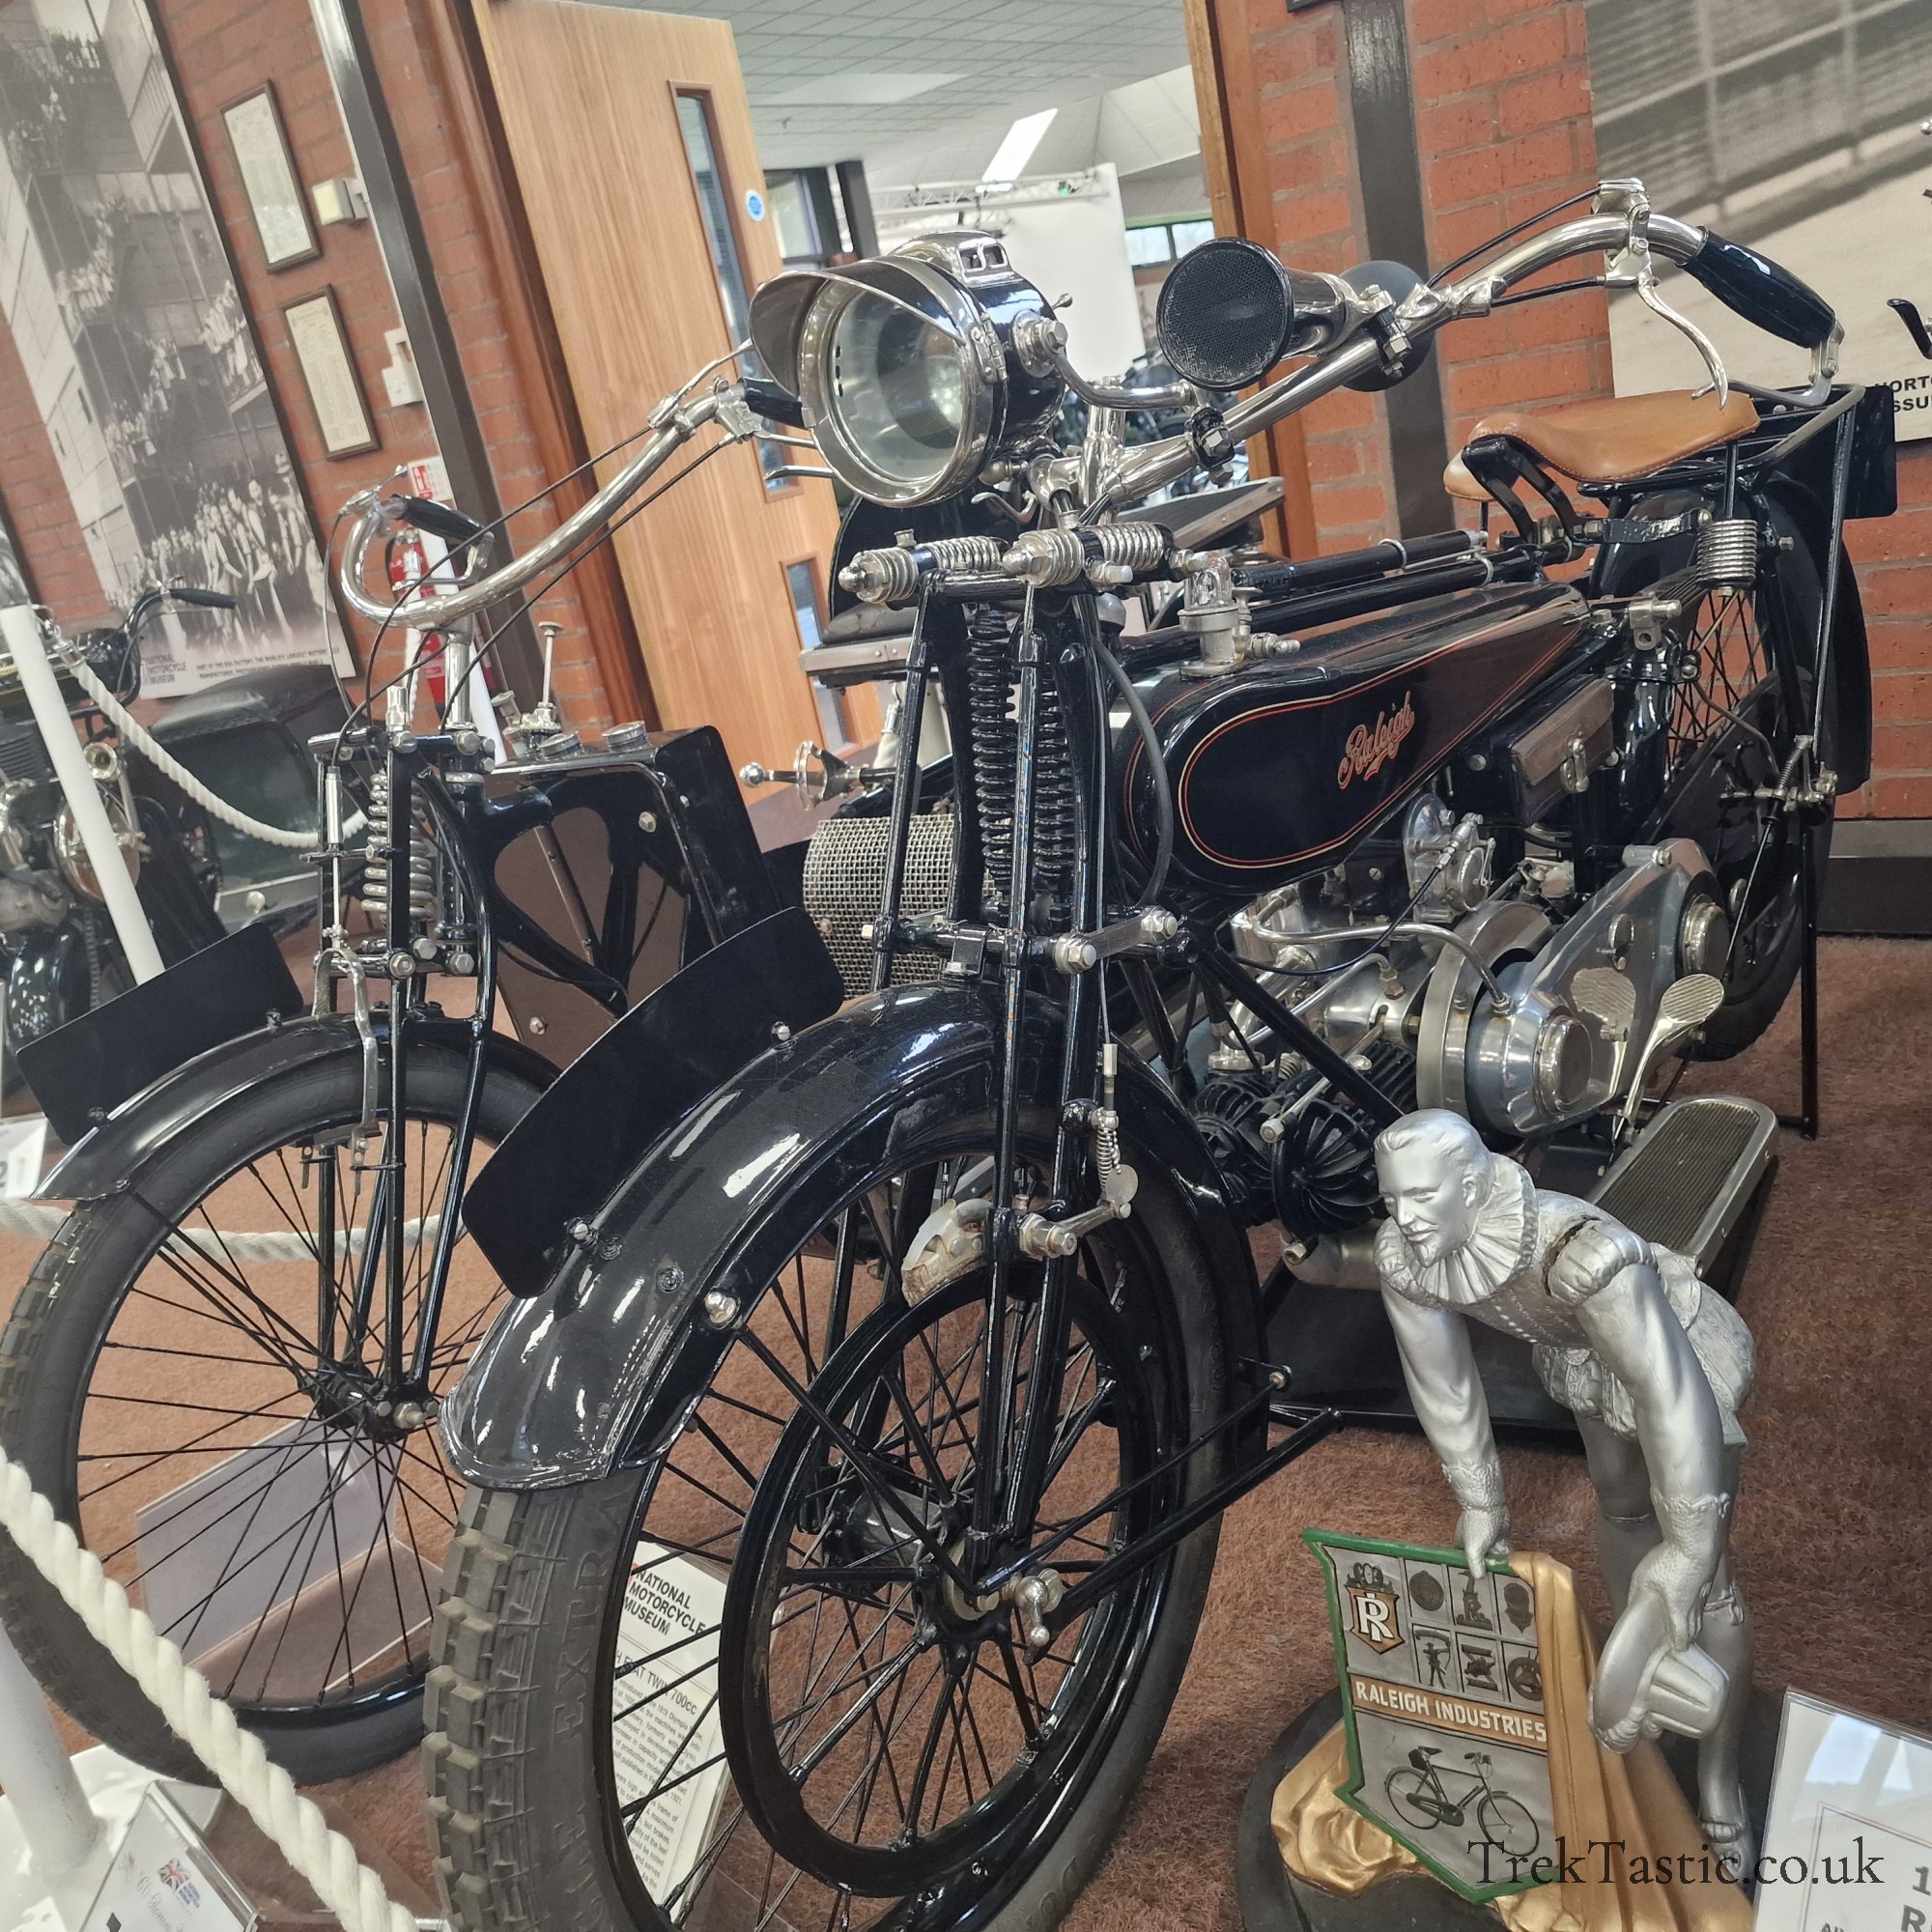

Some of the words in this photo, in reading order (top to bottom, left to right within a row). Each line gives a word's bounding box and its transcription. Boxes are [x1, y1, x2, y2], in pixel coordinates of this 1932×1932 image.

[1338, 690, 1415, 789] Raleigh
[628, 1581, 706, 1634] MOTORCYCLE
[637, 1570, 691, 1610] NATIONAL
[624, 1596, 671, 1635] MUSEUM
[670, 1689, 697, 1716] 700cc
[1355, 1681, 1430, 1716] RALEIGH
[1435, 1701, 1547, 1743] INDUSTRIES
